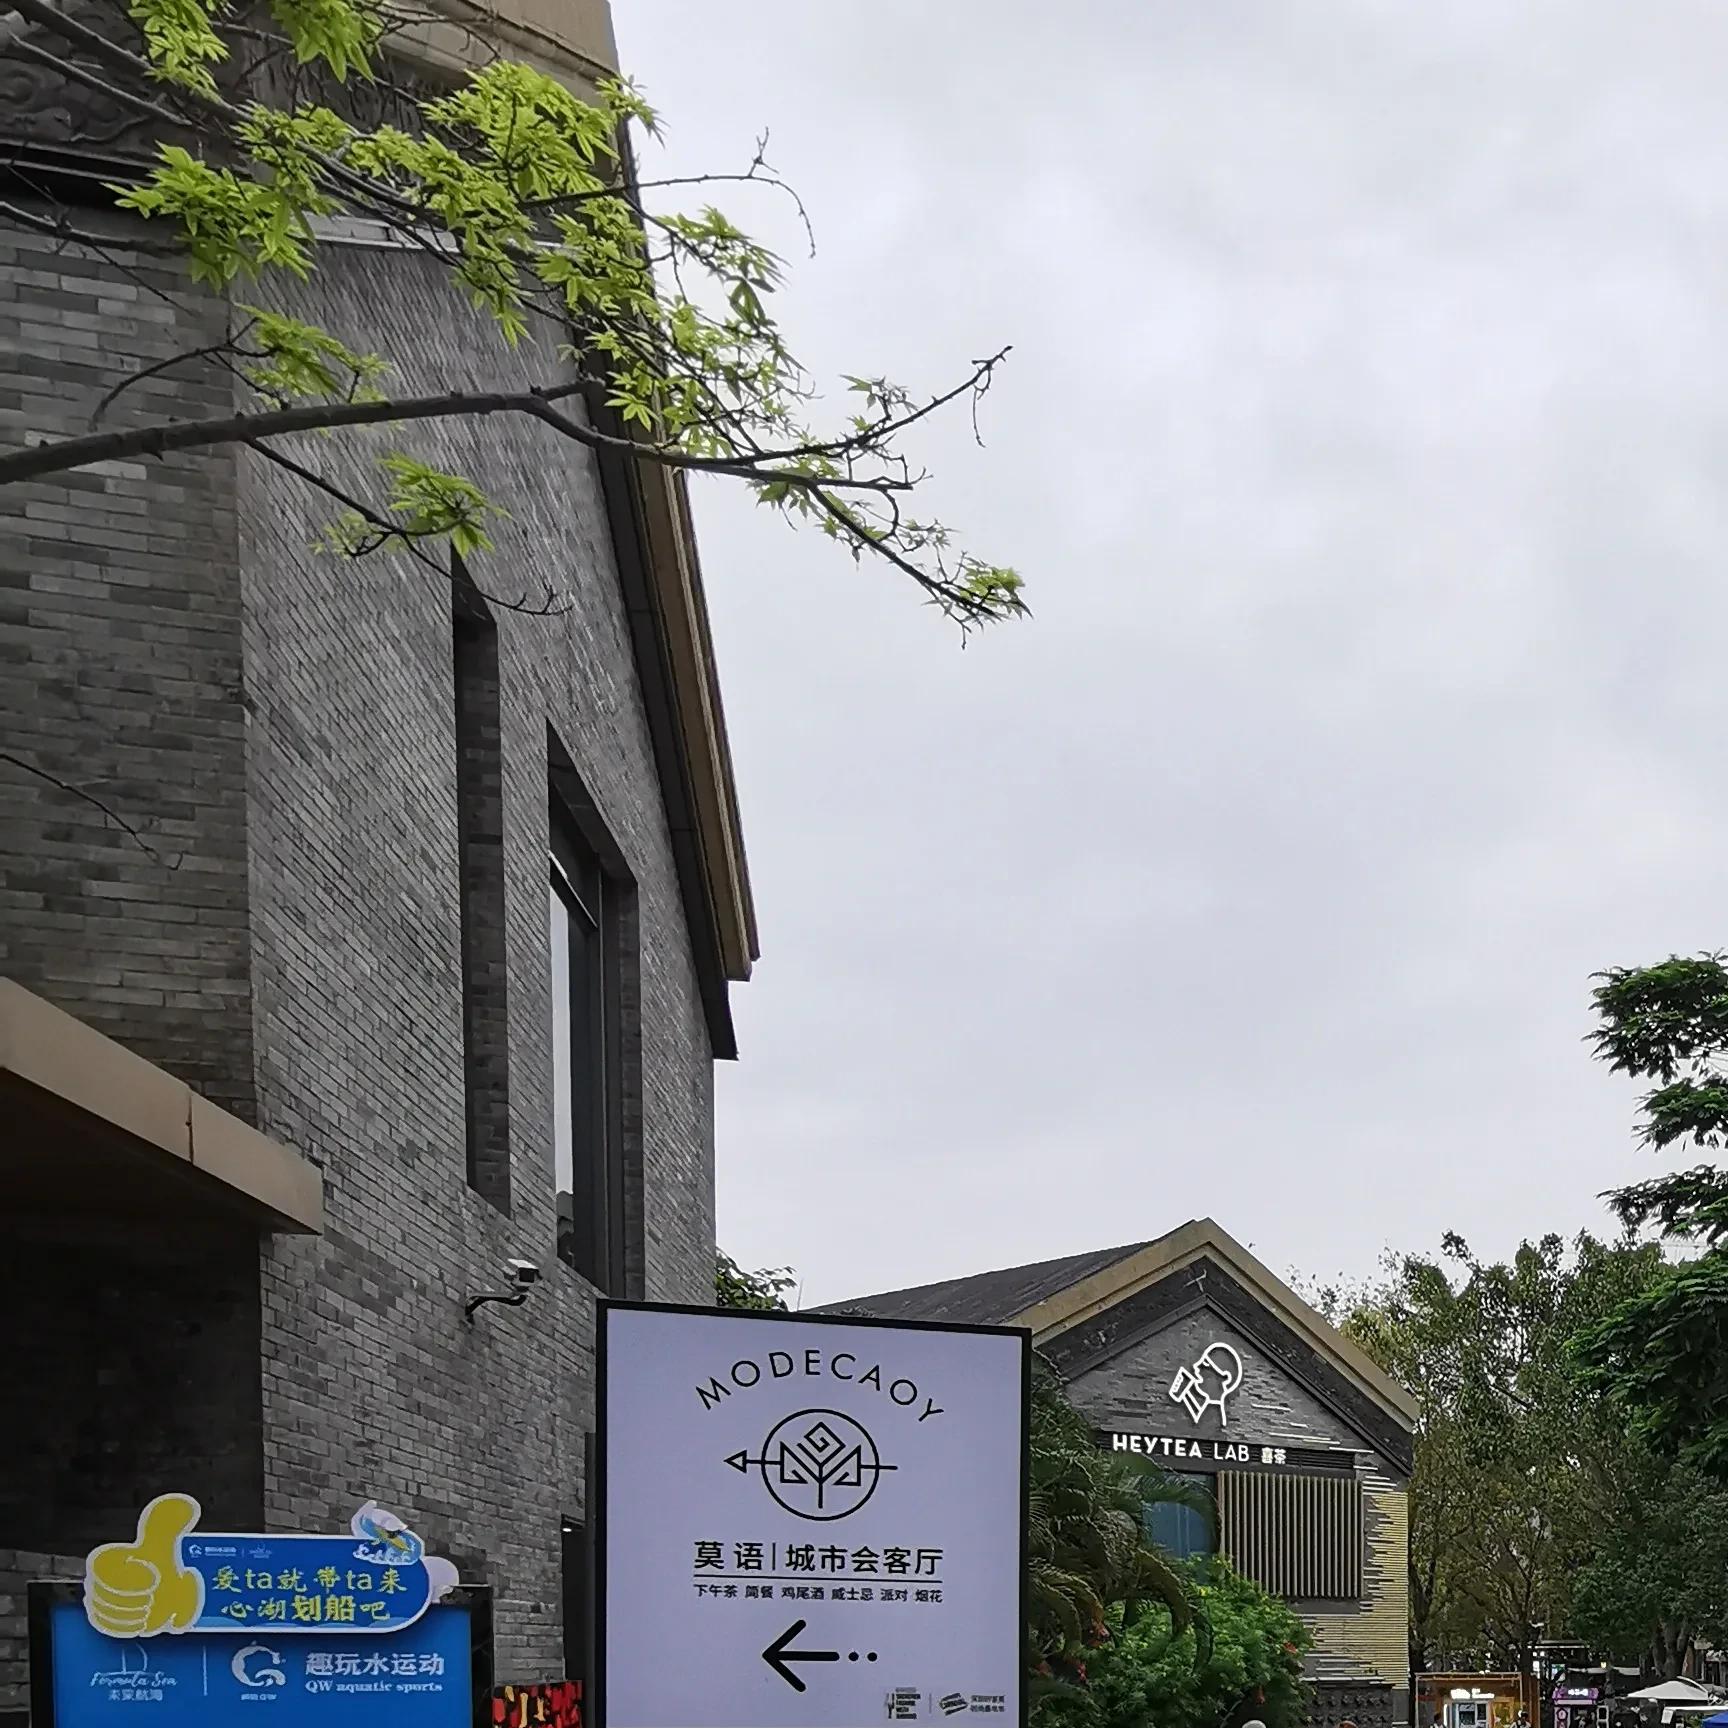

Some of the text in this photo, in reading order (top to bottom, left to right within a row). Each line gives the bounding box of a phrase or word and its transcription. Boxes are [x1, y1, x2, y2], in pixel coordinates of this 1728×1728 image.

[695, 1349, 945, 1422] MODECAOY
[1112, 1434, 1202, 1458] HEYTEA
[1214, 1442, 1250, 1462] LAB
[694, 1541, 944, 1576] 莫语 城市会客厅
[694, 1584, 943, 1603] 下午茶 简餐 鸡尾酒 威士忌 派对 烟花
[221, 1594, 391, 1622] 心湖划船吧
[305, 1652, 445, 1676] 趣玩水运动
[305, 1680, 443, 1694] QW aquatic sports
